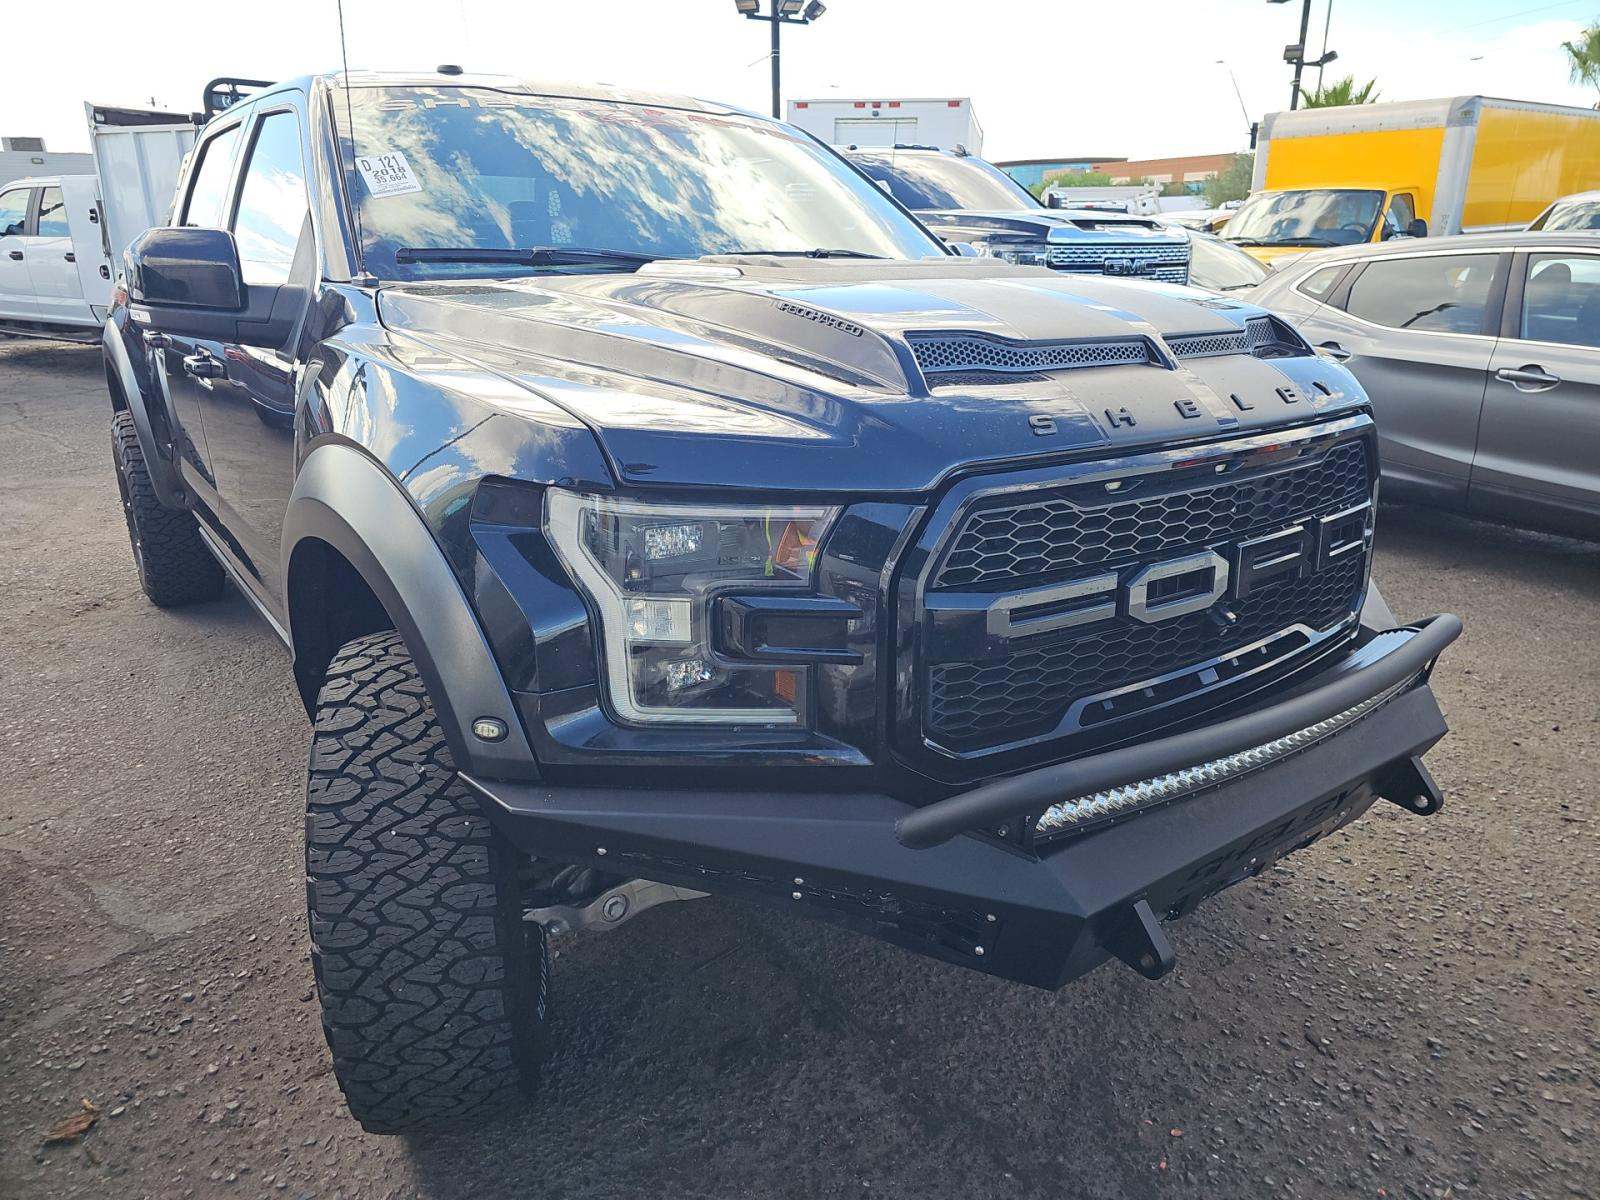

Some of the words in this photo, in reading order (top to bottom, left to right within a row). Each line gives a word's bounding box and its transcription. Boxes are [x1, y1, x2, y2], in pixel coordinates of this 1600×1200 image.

[361, 159, 372, 172] D
[378, 155, 400, 169] 121
[372, 166, 406, 178] 2018
[375, 173, 408, 184] 35,664
[1104, 258, 1158, 275] GMC
[1028, 380, 1332, 437] SHELBY
[986, 499, 1372, 639] FORD
